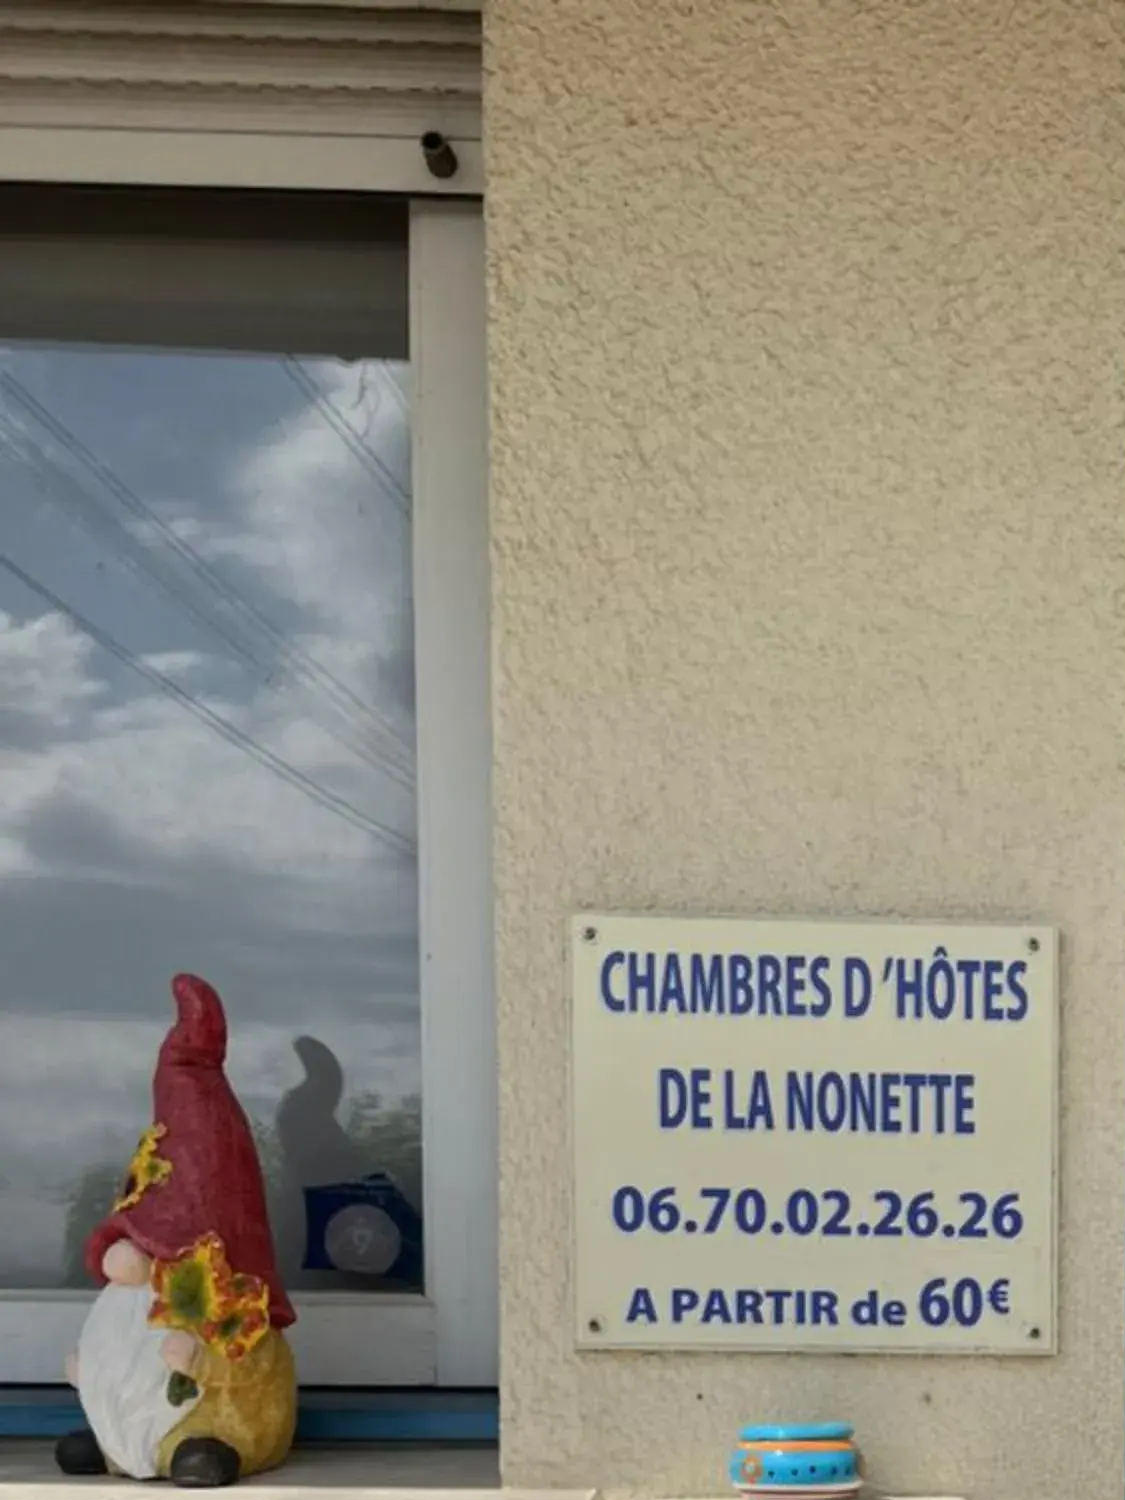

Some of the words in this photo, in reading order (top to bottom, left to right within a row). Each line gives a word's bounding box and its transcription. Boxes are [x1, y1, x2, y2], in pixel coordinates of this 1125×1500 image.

[600, 951, 832, 1018] CHAMBRES
[658, 1068, 712, 1129] DE
[723, 1069, 775, 1131] LA
[786, 1071, 976, 1134] NONETTE
[611, 1186, 1024, 1239] 06.70.02.26.26
[625, 1288, 659, 1324] A
[670, 1289, 840, 1326] PARTIR
[850, 1290, 908, 1326] de
[919, 1277, 1011, 1327] 60€
